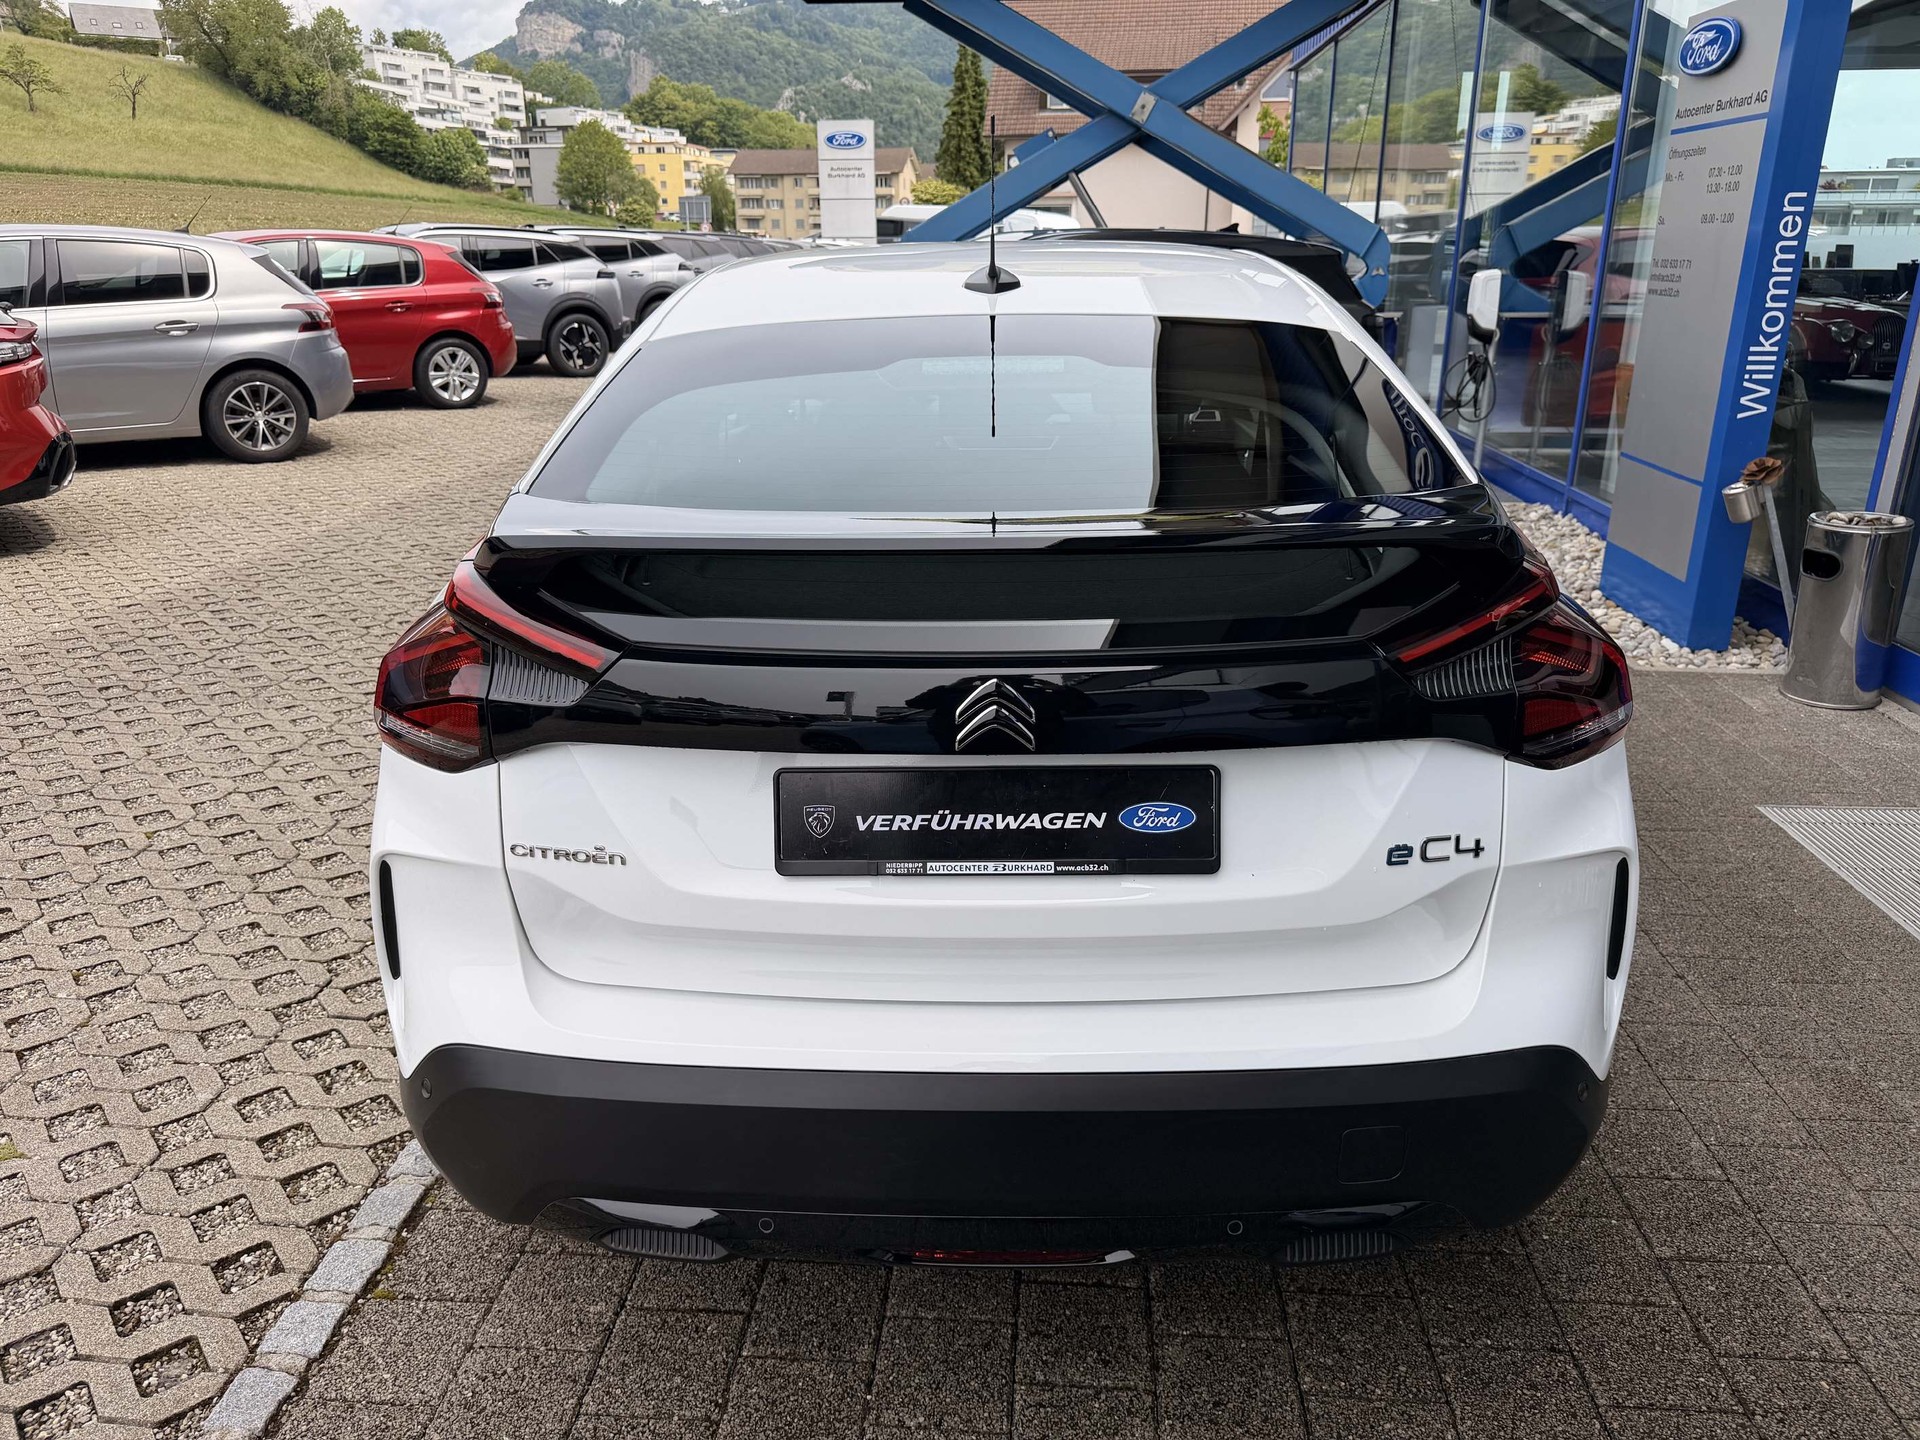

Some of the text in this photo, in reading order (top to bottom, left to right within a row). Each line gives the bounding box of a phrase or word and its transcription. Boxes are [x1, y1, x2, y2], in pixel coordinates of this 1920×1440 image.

[1685, 29, 1723, 66] Ford
[1675, 89, 1768, 120] Autocenter Burkhard AG
[832, 133, 859, 145] Ford
[1668, 145, 1707, 160] Öffnungszeiten
[1708, 166, 1723, 178] 07.30
[1727, 164, 1743, 176] 12.00
[1706, 182, 1721, 194] 13.30
[1701, 213, 1715, 224] 09.00
[1720, 212, 1735, 223] 12.00
[1737, 191, 1808, 419] Willkommen
[855, 810, 1107, 832] VERFÜHRWAGEN
[1132, 805, 1181, 828] Ford
[928, 864, 989, 873] AUTOCENTER
[1056, 864, 1109, 872] www.acb32.ch
